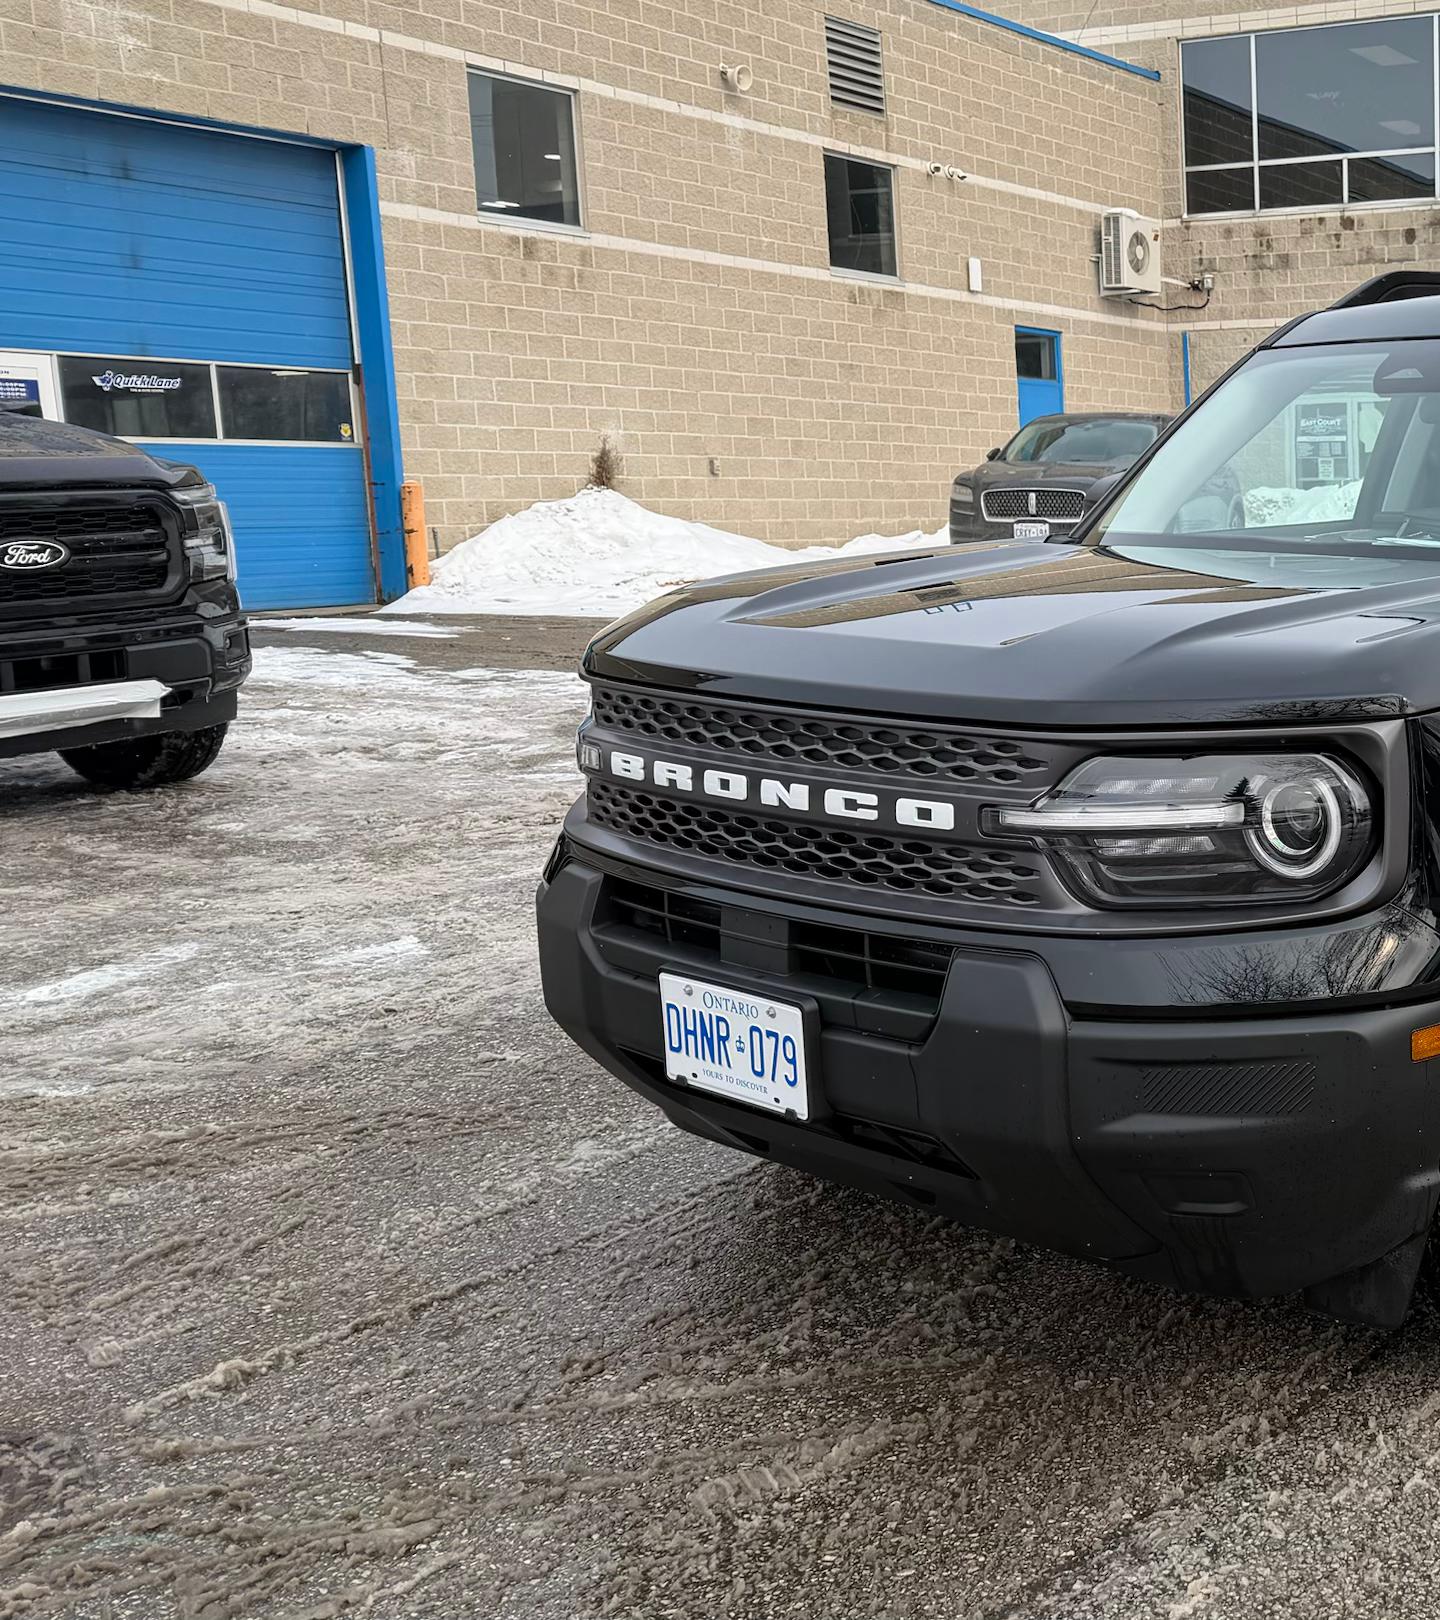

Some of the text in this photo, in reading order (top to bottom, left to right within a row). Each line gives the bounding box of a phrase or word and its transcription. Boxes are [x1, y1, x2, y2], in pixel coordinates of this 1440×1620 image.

[4, 545, 51, 565] Ford
[610, 751, 955, 831] BRONCO
[702, 991, 759, 1020] ONTARIO
[665, 1002, 798, 1087] DHNR 079
[702, 1068, 769, 1095] YOURS TO DISCOVER
